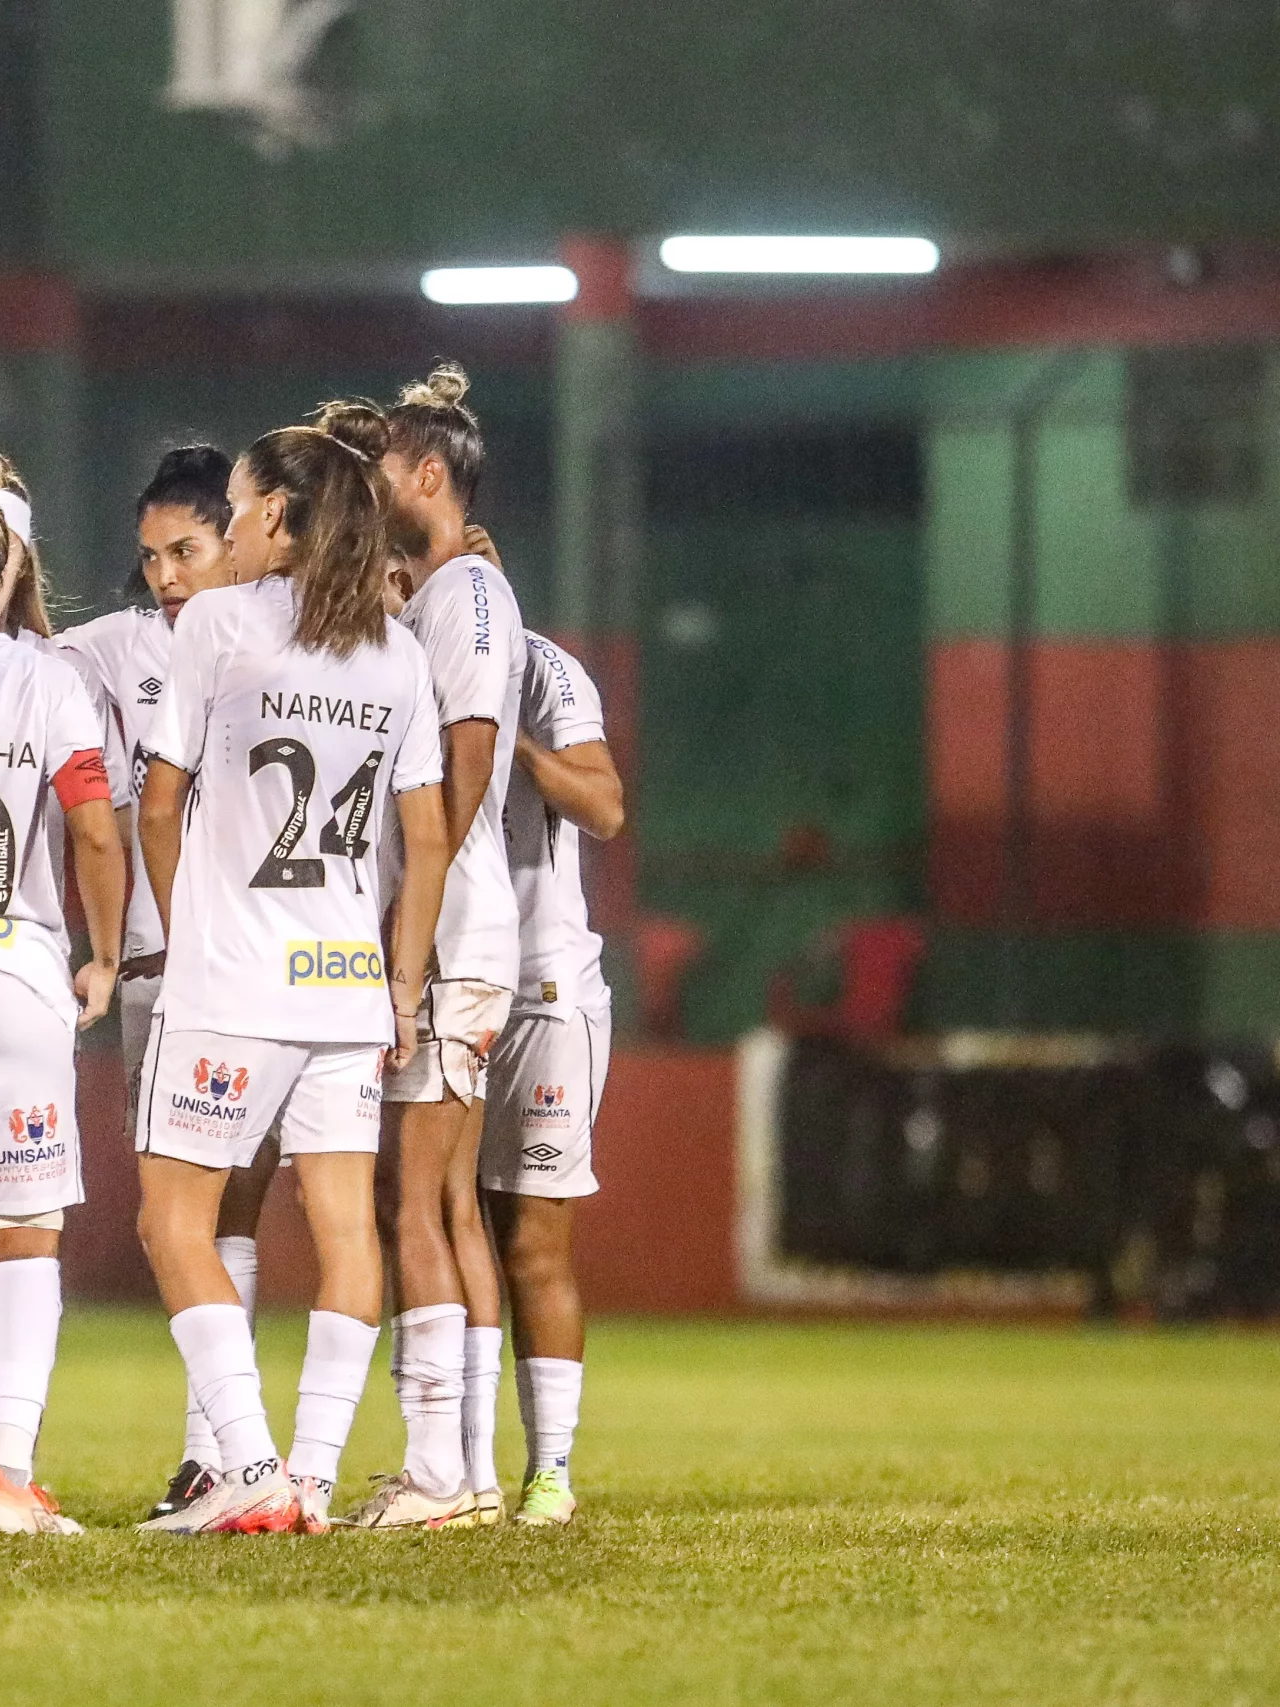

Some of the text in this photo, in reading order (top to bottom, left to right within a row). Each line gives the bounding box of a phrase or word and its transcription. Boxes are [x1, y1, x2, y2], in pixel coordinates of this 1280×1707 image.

[261, 692, 393, 735] NARVAEZ
[248, 737, 385, 895] 24
[288, 941, 382, 986] placo
[171, 1093, 247, 1121] UNISANTA
[522, 1107, 571, 1118] UNISANTA
[167, 1118, 202, 1134] SANTA
[523, 1163, 558, 1172] umbro
